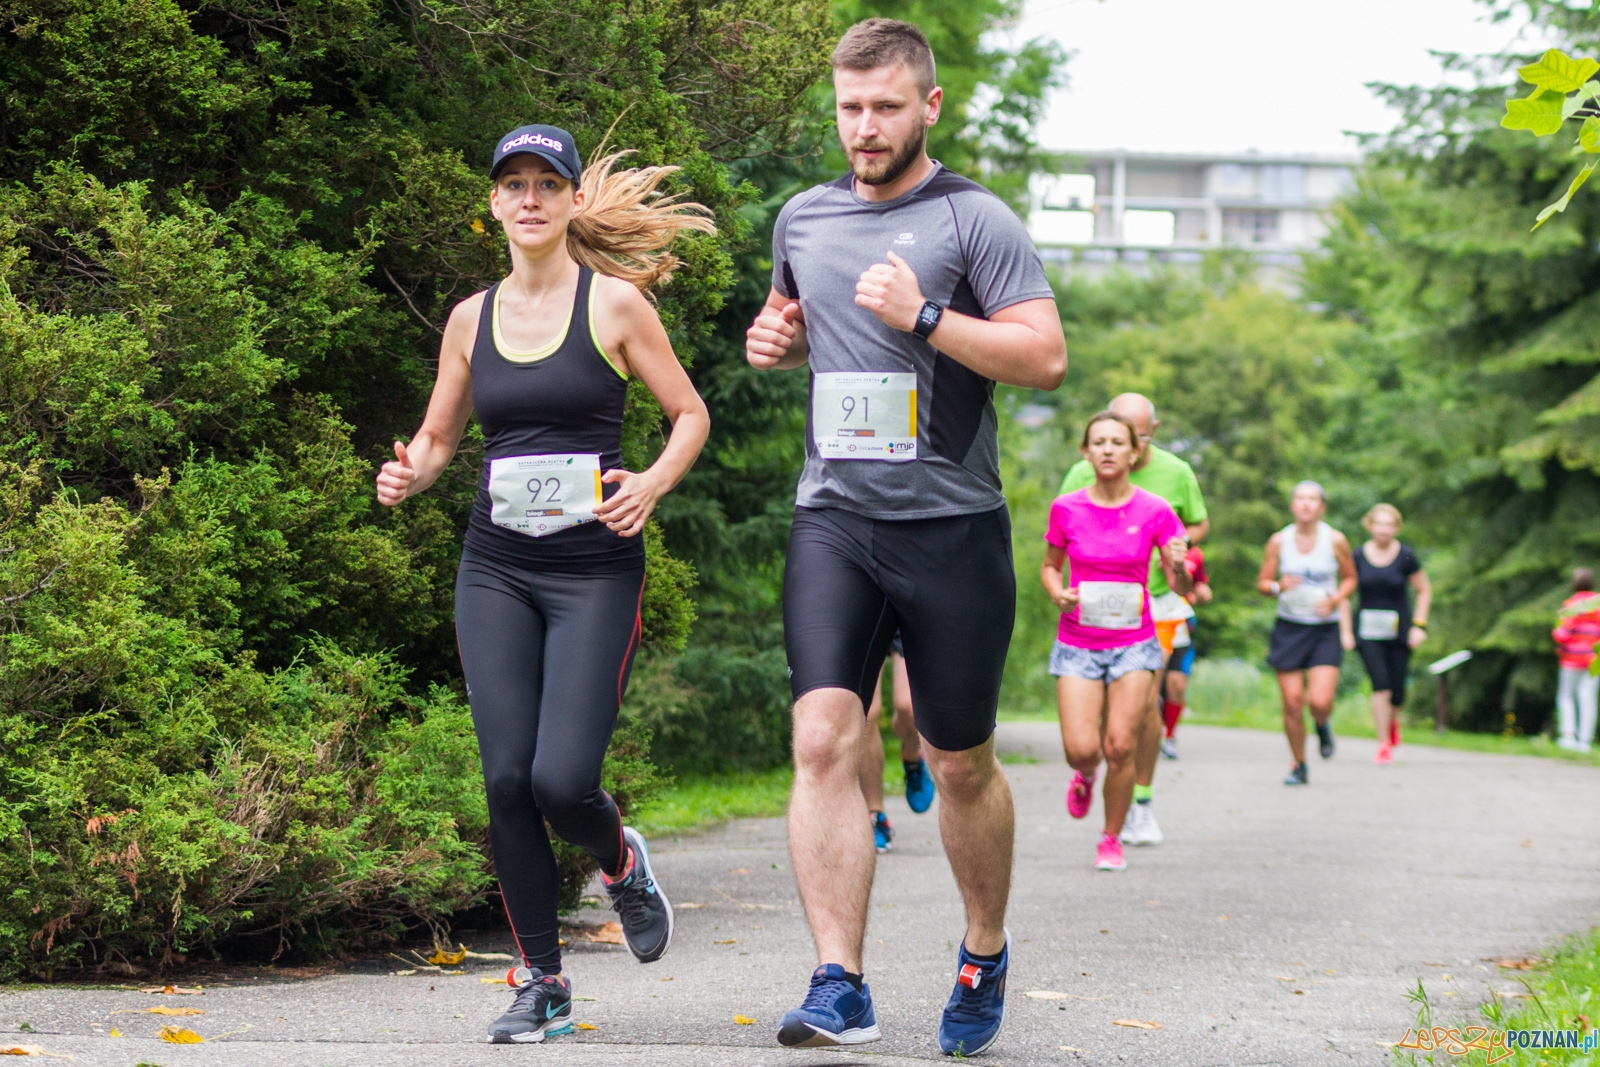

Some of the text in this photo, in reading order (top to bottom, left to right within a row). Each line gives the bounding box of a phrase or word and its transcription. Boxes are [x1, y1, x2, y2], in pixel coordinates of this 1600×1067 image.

[502, 133, 564, 153] adidas
[841, 396, 868, 422] 91
[896, 442, 915, 451] mjp
[526, 477, 562, 504] 92
[1100, 594, 1127, 610] 109
